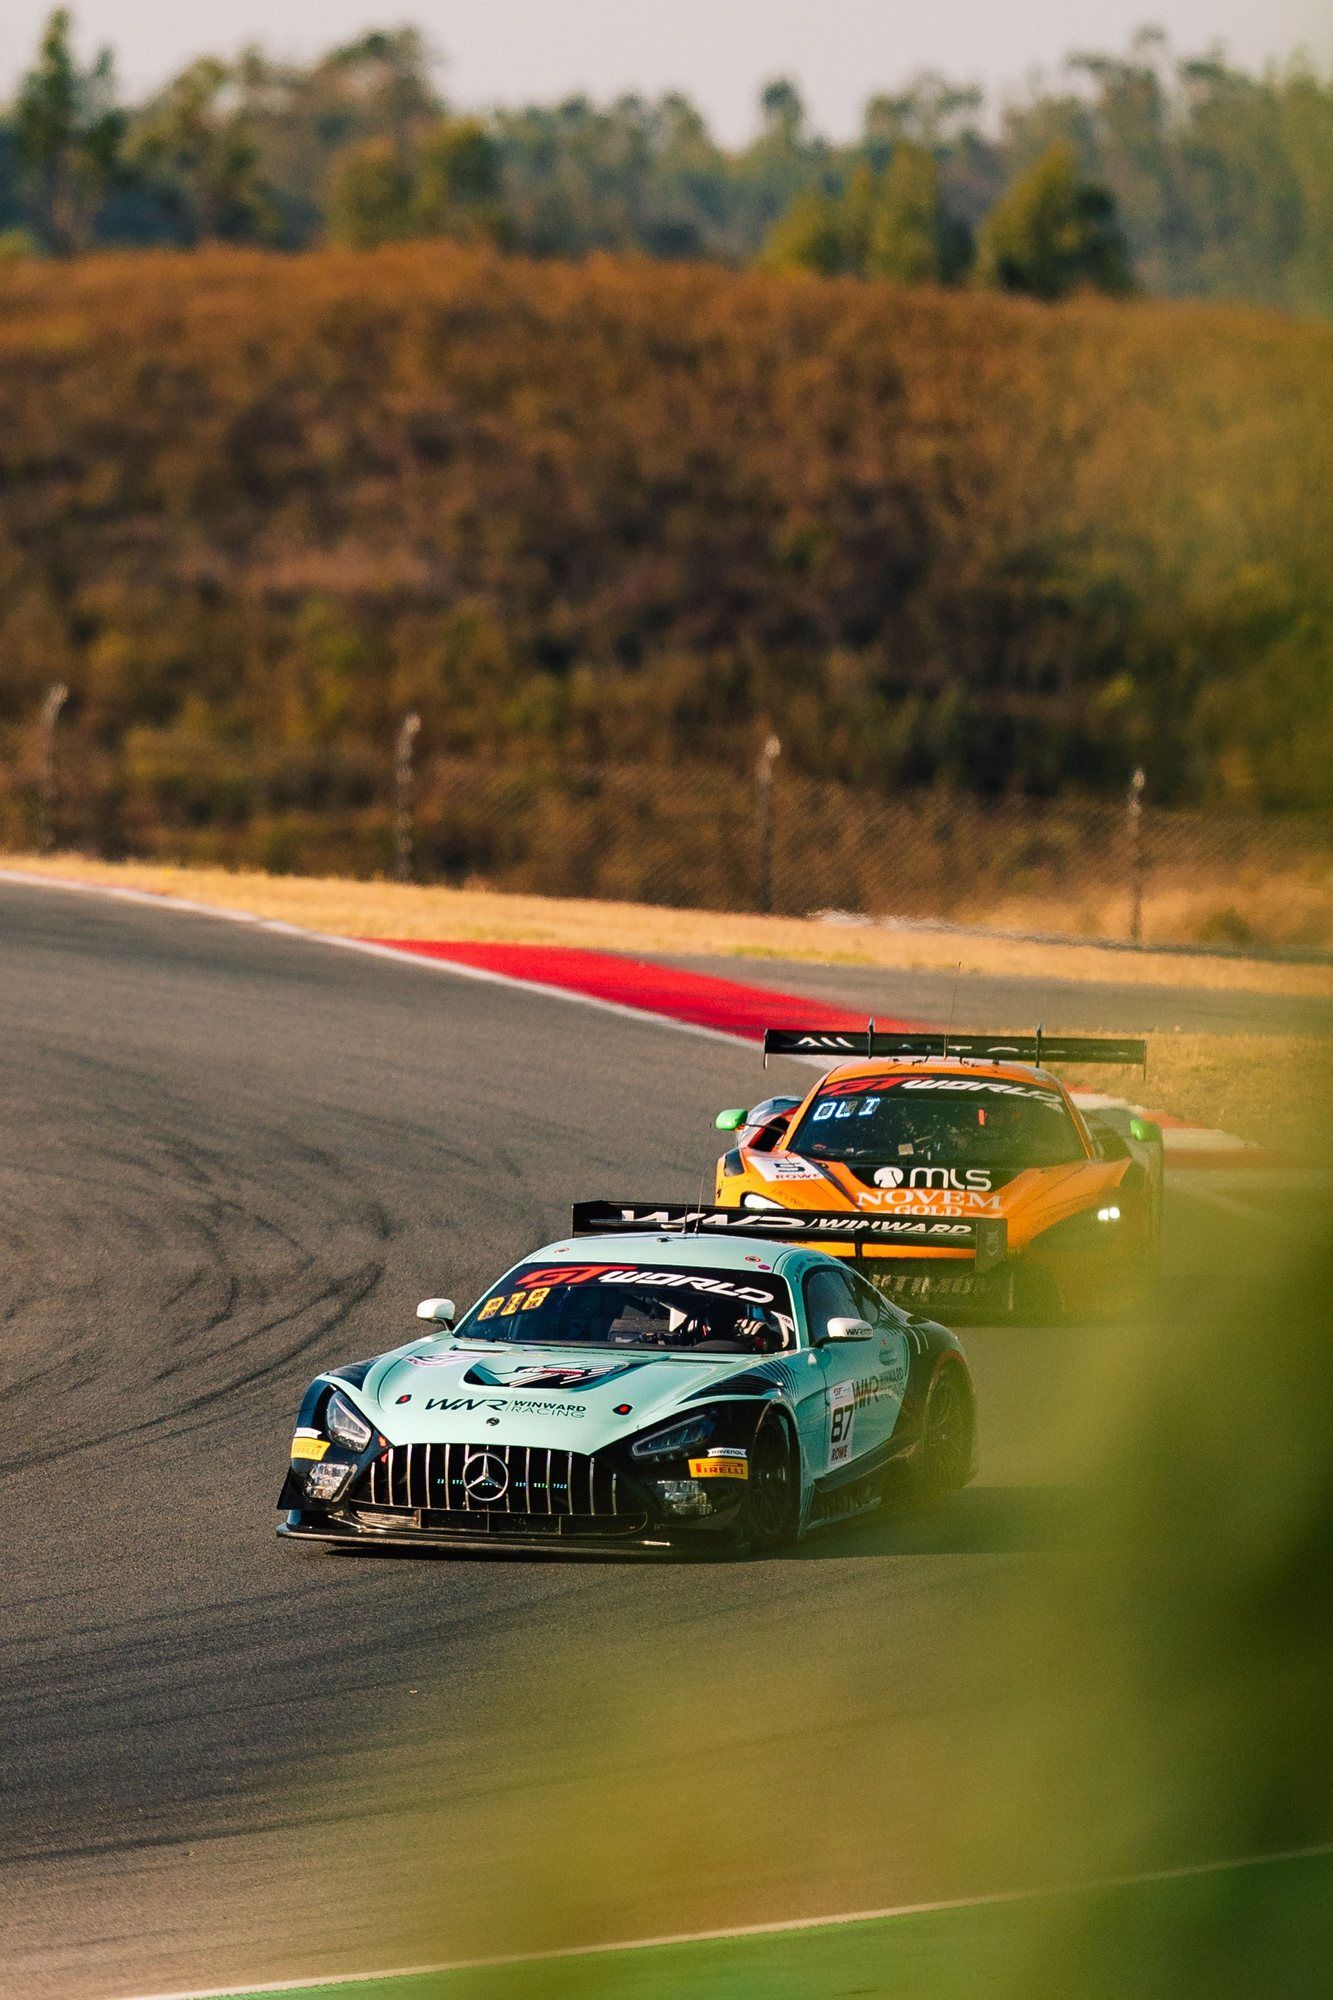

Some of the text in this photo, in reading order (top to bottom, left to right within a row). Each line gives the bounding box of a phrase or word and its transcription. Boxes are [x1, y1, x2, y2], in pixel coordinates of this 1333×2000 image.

[817, 1075, 1064, 1102] GT WORLD
[774, 1161, 806, 1173] 5
[856, 1189, 1003, 1210] NOVEM
[893, 1204, 964, 1217] GOLD
[817, 1218, 972, 1234] WINWARD
[516, 1265, 637, 1289] GT
[597, 1270, 774, 1304] WORLD
[425, 1398, 587, 1412] WNR WINWARD
[510, 1405, 585, 1419] RACING
[831, 1403, 854, 1444] 87
[695, 1462, 744, 1476] PIRELLI
